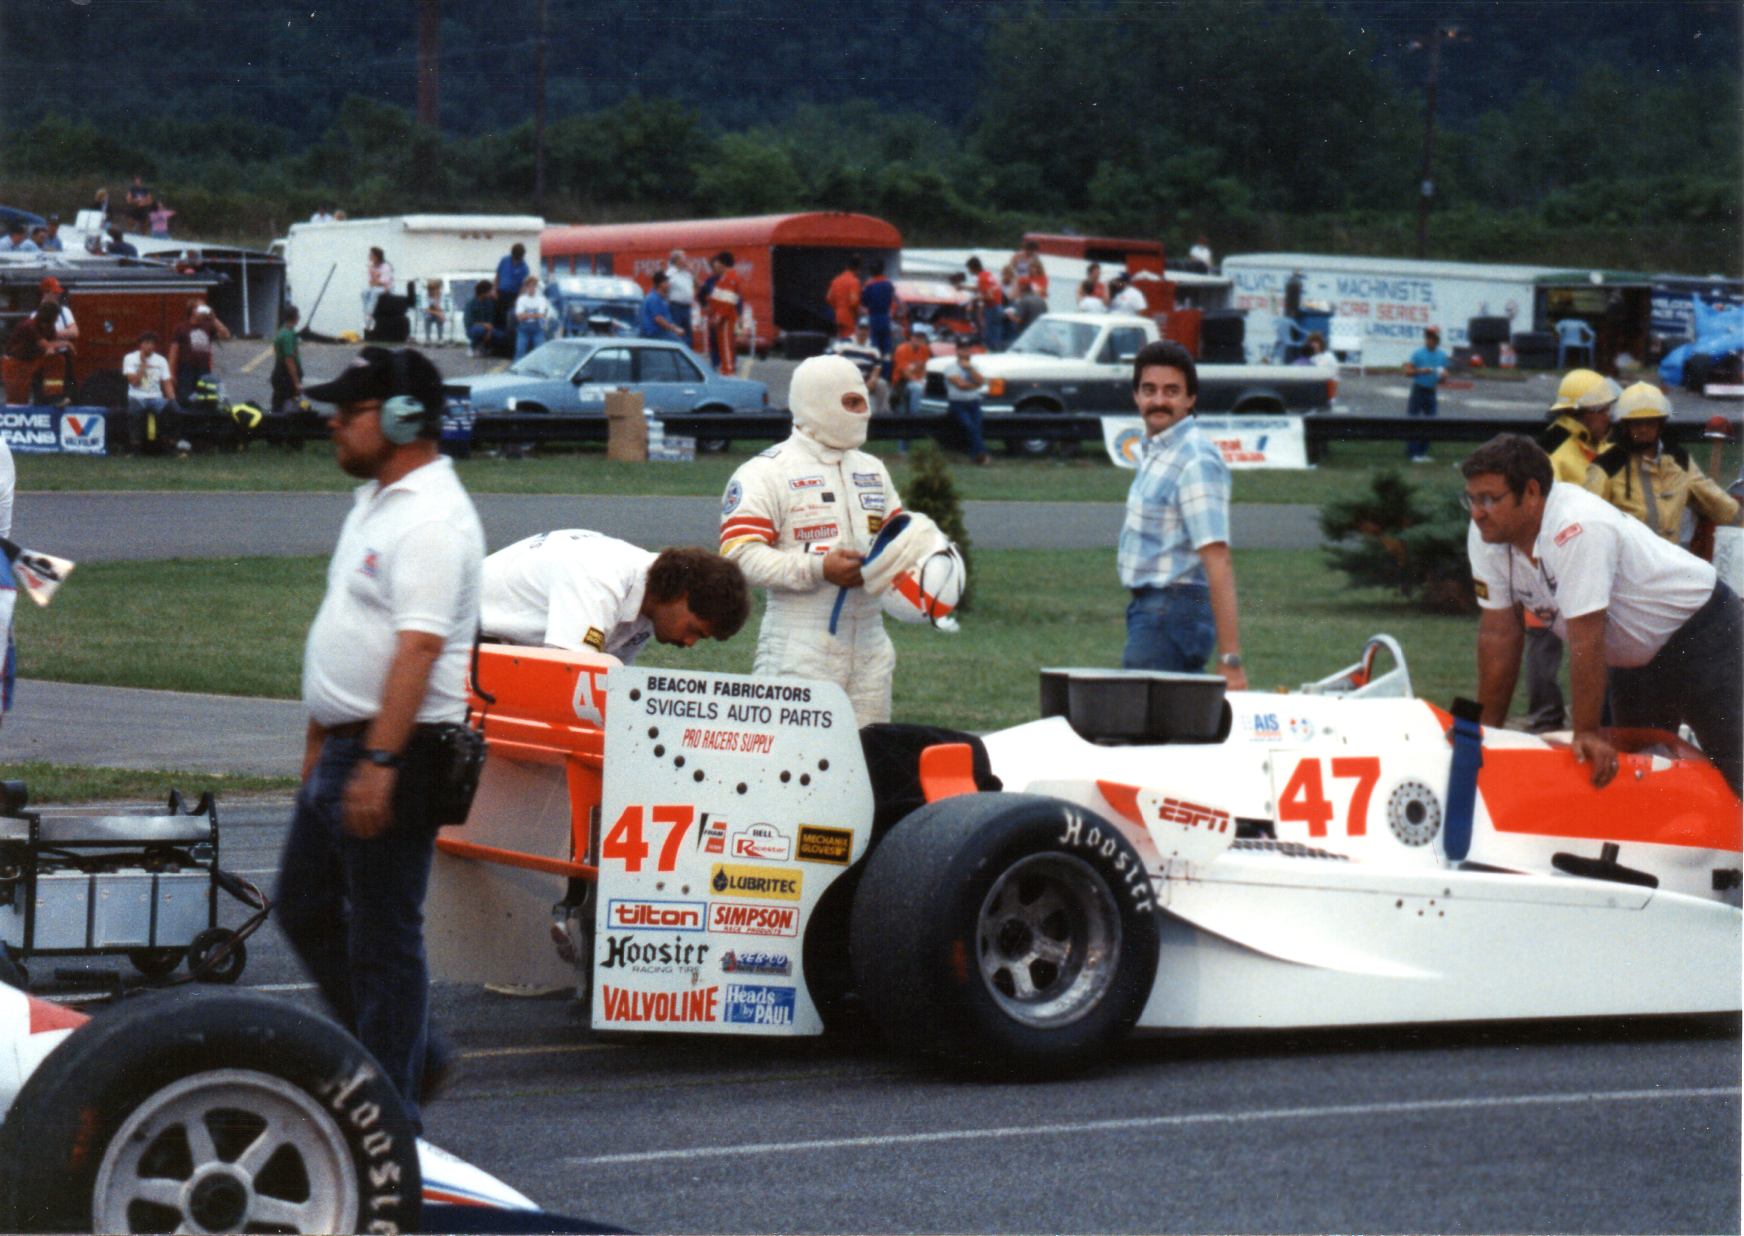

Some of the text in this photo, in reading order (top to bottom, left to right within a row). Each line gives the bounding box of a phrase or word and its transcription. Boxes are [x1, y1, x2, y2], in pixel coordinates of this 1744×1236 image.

[1337, 278, 1433, 302] MACHINISTS
[1376, 302, 1429, 322] SERIES
[798, 526, 838, 541] Autolite
[647, 676, 812, 703] BEACON FABRICATORS
[645, 698, 833, 729] SVIGELS AUTO PARTS
[1254, 713, 1281, 732] AIS
[681, 728, 775, 755] PRO RACERS SUPPLY
[1278, 757, 1381, 837] 47
[1158, 797, 1231, 834] ESPN
[602, 805, 695, 872] 47
[752, 828, 773, 839] BELL
[1058, 807, 1153, 912] Hoosier
[729, 876, 797, 895] LUBRITEC
[615, 903, 699, 926] tilton
[714, 905, 793, 929] SIMPSON
[600, 934, 710, 968] Hoosier
[632, 965, 672, 974] RACING
[603, 984, 720, 1022] VALVOLINE
[727, 984, 776, 1005] Heads
[742, 1004, 755, 1018] by
[753, 1005, 792, 1025] PAUL
[318, 1063, 401, 1235] Hoosie
